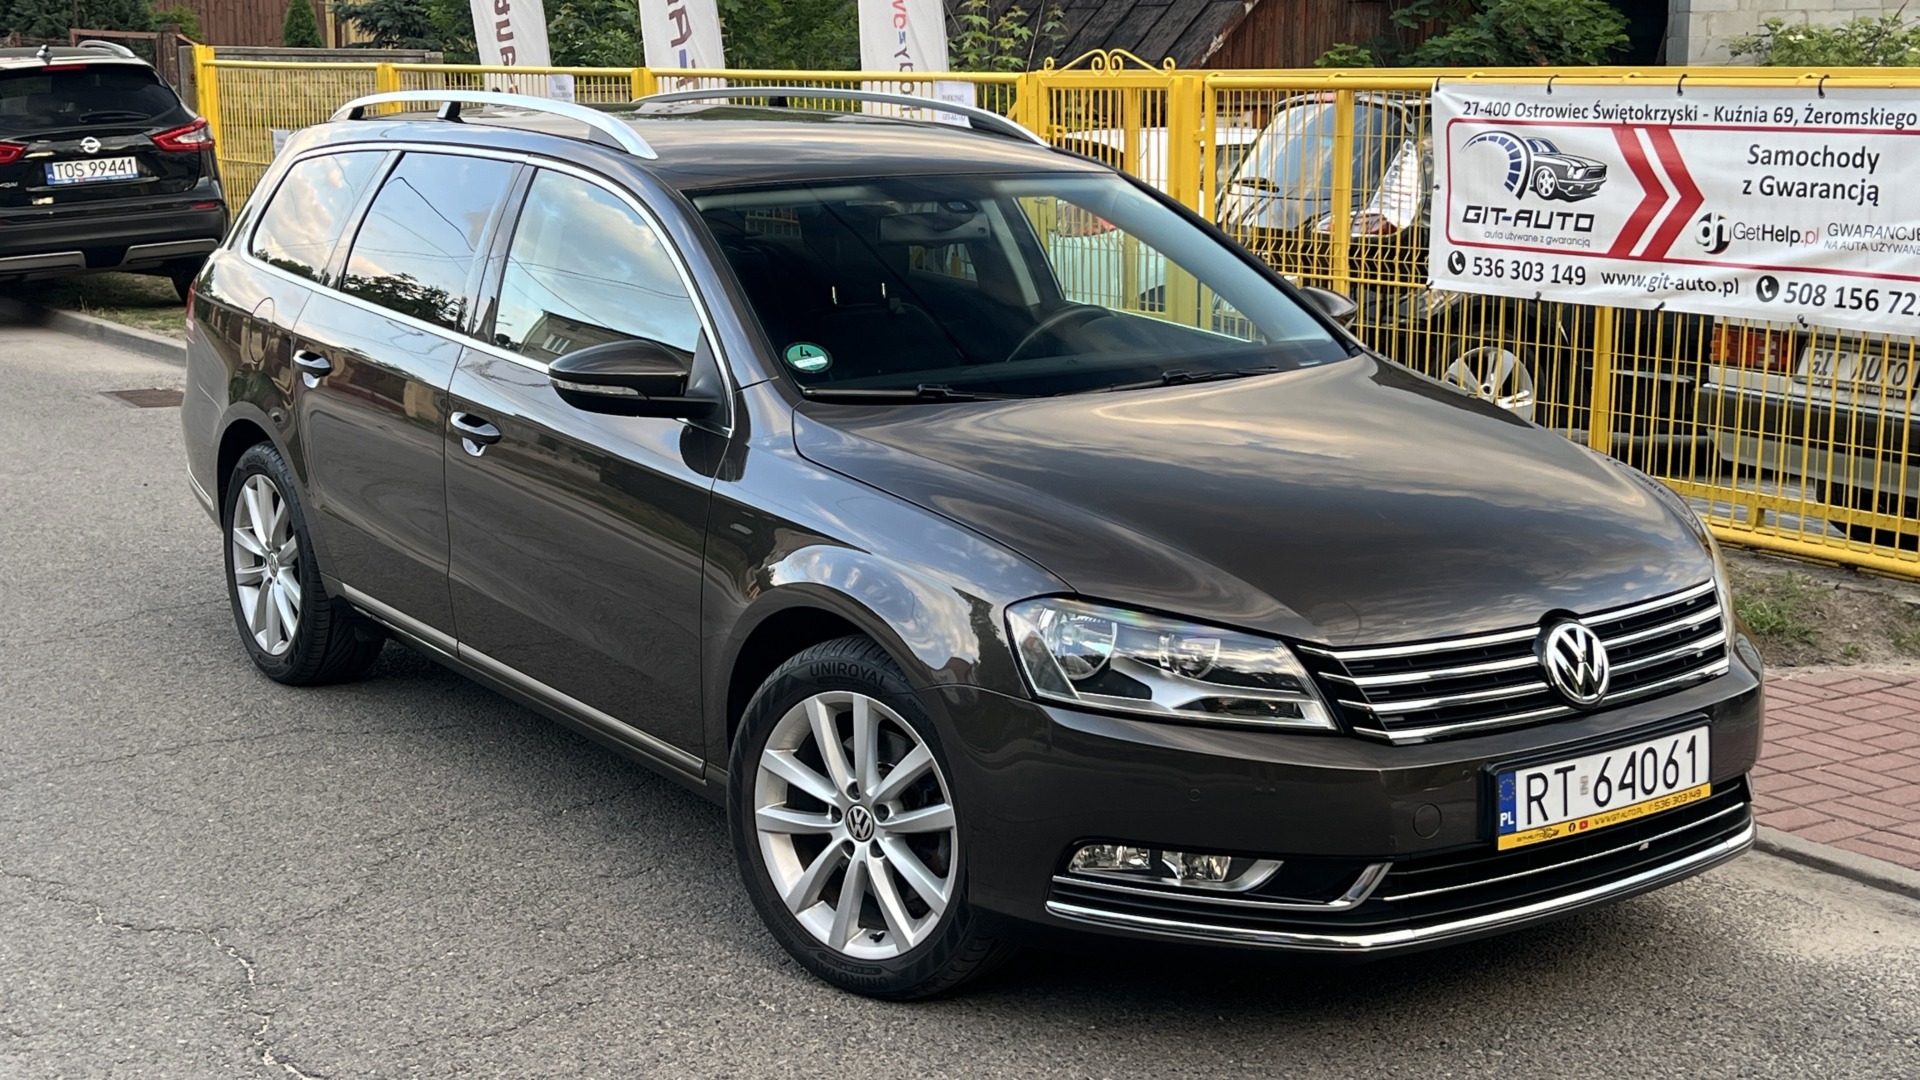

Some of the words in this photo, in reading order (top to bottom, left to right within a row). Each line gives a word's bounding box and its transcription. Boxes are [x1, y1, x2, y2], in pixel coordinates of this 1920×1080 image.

[1463, 101, 1510, 117] 27-400
[1515, 102, 1588, 119] Ostrowiec
[1592, 100, 1698, 125] Świętokrzyski
[1714, 105, 1768, 123] Kuźnia
[1773, 107, 1798, 127] 69,
[1804, 103, 1917, 130] Żeromskiego
[55, 163, 84, 179] TOS
[89, 158, 136, 176] 99441
[1747, 144, 1880, 174] Samochody
[1743, 180, 1751, 195] z
[1759, 175, 1879, 206] Gwarancją
[1462, 205, 1595, 232] GIT-AUTO
[1484, 230, 1504, 239] auta
[1505, 231, 1539, 244] używane
[1546, 234, 1591, 248] gwarancją
[1733, 222, 1819, 248] GetHelp.pl
[1824, 240, 1837, 250] NA
[1840, 241, 1868, 252] AUTA
[1472, 256, 1504, 278] 536
[1510, 260, 1544, 282] 303
[1550, 264, 1586, 285] 149
[1600, 270, 1739, 297] www.git-auto.pl
[1784, 282, 1827, 306] 508
[1834, 286, 1879, 311] 156
[1888, 290, 1920, 317] 72
[810, 662, 886, 688] UNIROYAL
[1500, 811, 1514, 827] PL
[1526, 765, 1576, 825] RT
[1593, 735, 1697, 807] 64061
